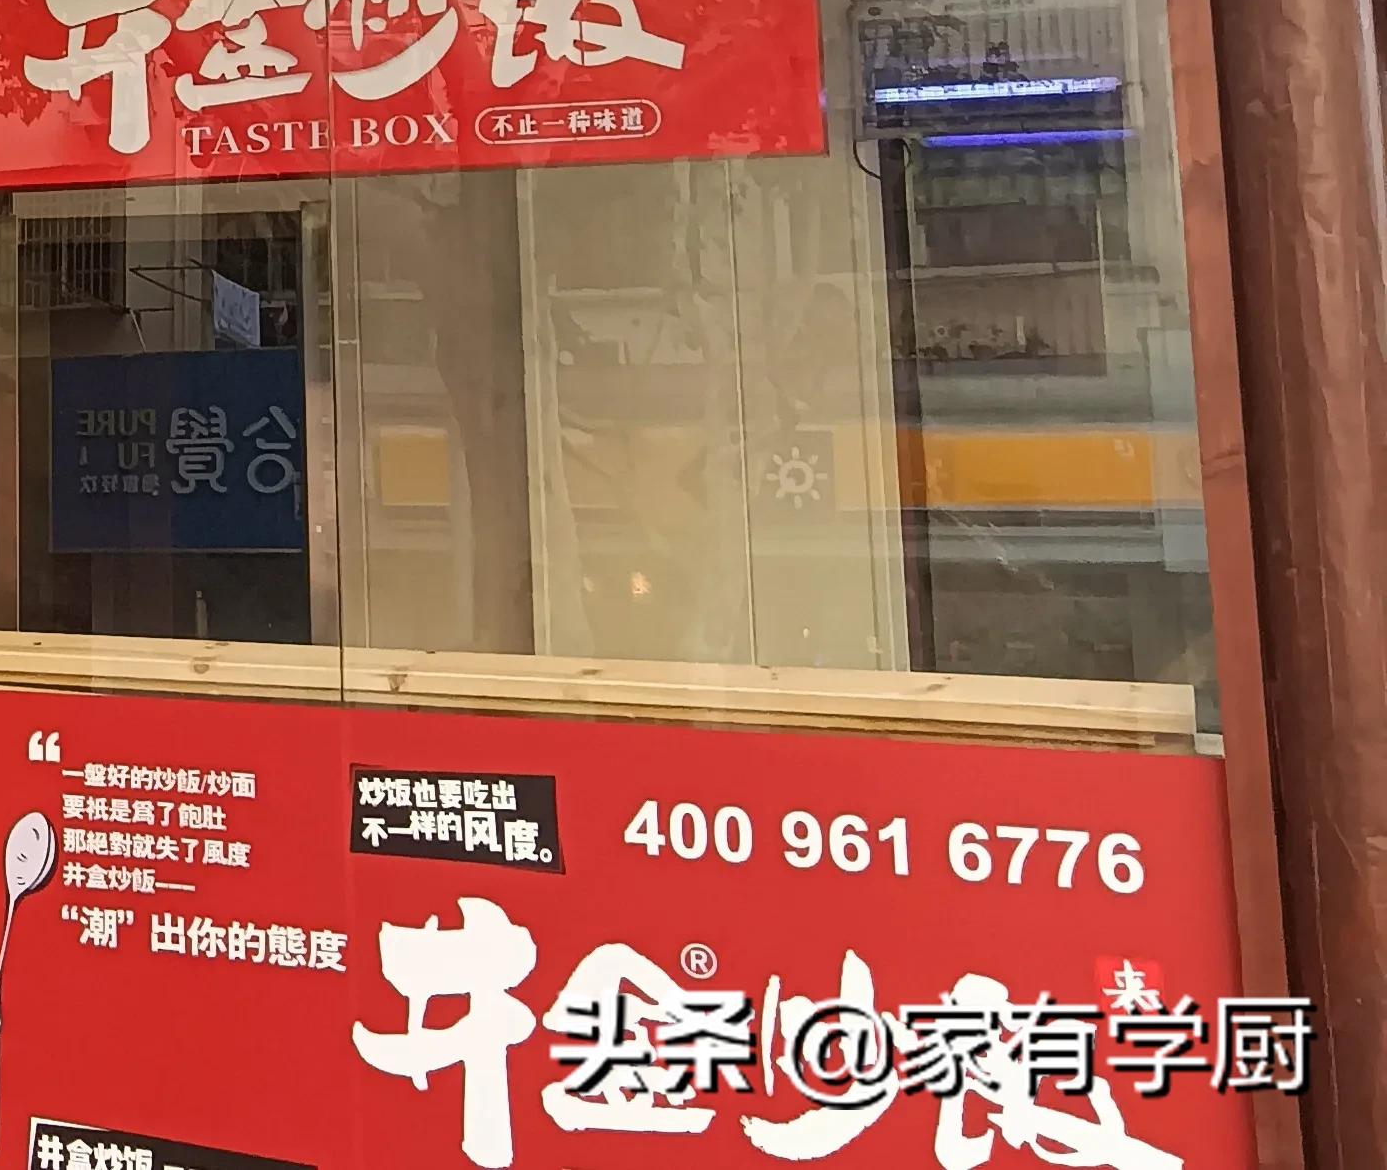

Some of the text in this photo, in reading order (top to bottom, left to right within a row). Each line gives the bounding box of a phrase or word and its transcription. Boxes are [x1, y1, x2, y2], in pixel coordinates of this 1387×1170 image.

[182, 111, 457, 157] TASTE BOX
[490, 106, 645, 138] 不止一种味道
[358, 777, 517, 812] 炒饭也要吃出
[623, 800, 1147, 894] 400 961 6776
[150, 912, 348, 972] 出你的態度
